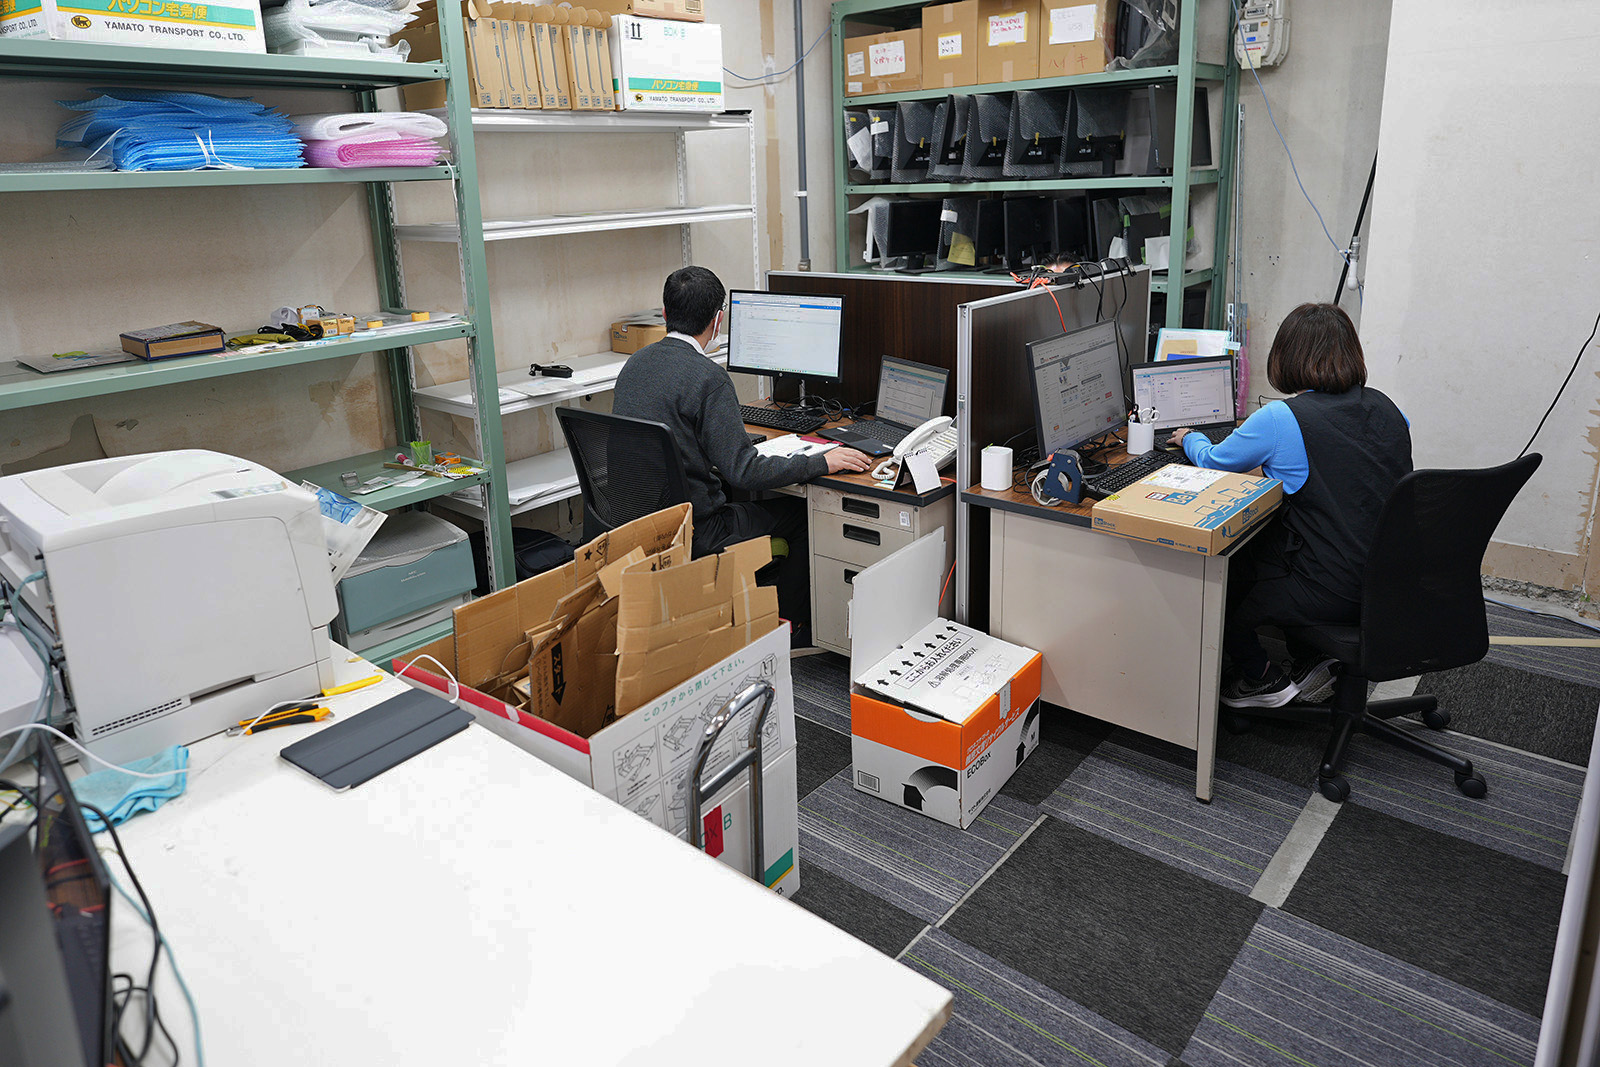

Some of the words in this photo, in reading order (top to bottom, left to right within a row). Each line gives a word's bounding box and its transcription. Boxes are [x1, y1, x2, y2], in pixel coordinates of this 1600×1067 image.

[104, 21, 145, 32] YAMATO
[149, 25, 204, 37] TRANSPORT
[905, 638, 962, 682] ここからお入れください
[643, 658, 745, 722] このフタから閉じて下さい。
